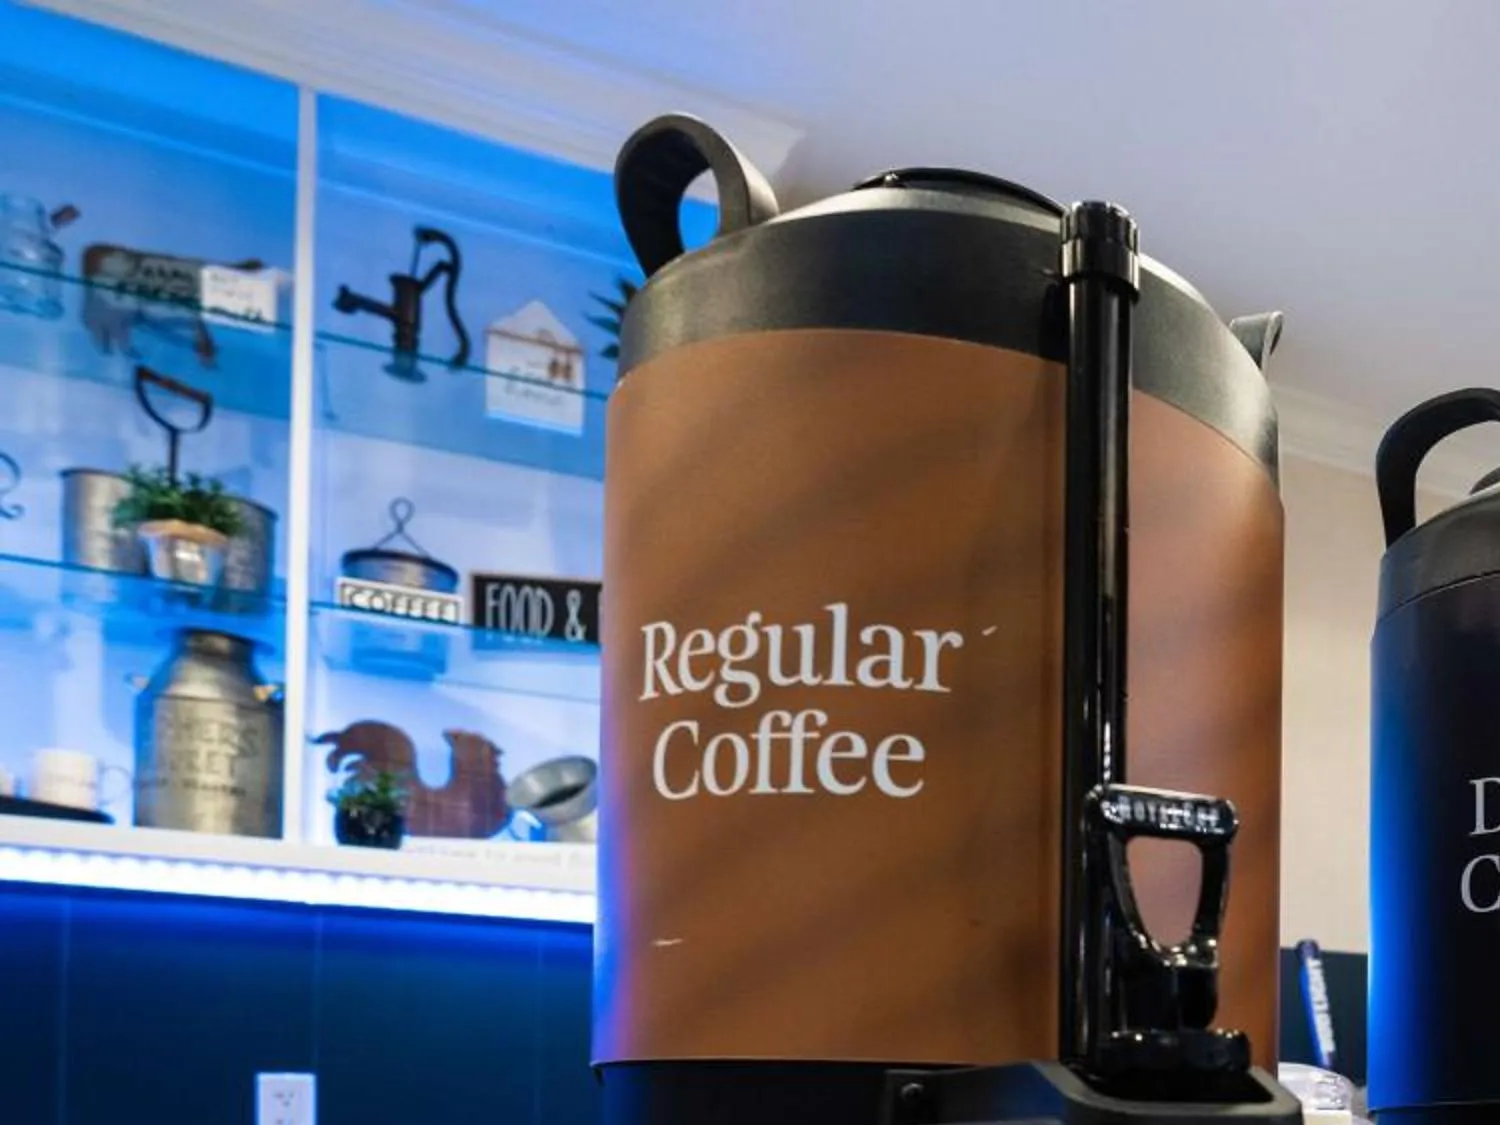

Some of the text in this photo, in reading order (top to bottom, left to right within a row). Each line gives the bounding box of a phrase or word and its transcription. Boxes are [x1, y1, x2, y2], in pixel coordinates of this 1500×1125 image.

[485, 582, 555, 640] FOOD
[564, 589, 587, 642] &
[638, 601, 964, 709] Regular
[652, 708, 926, 801] Coffee
